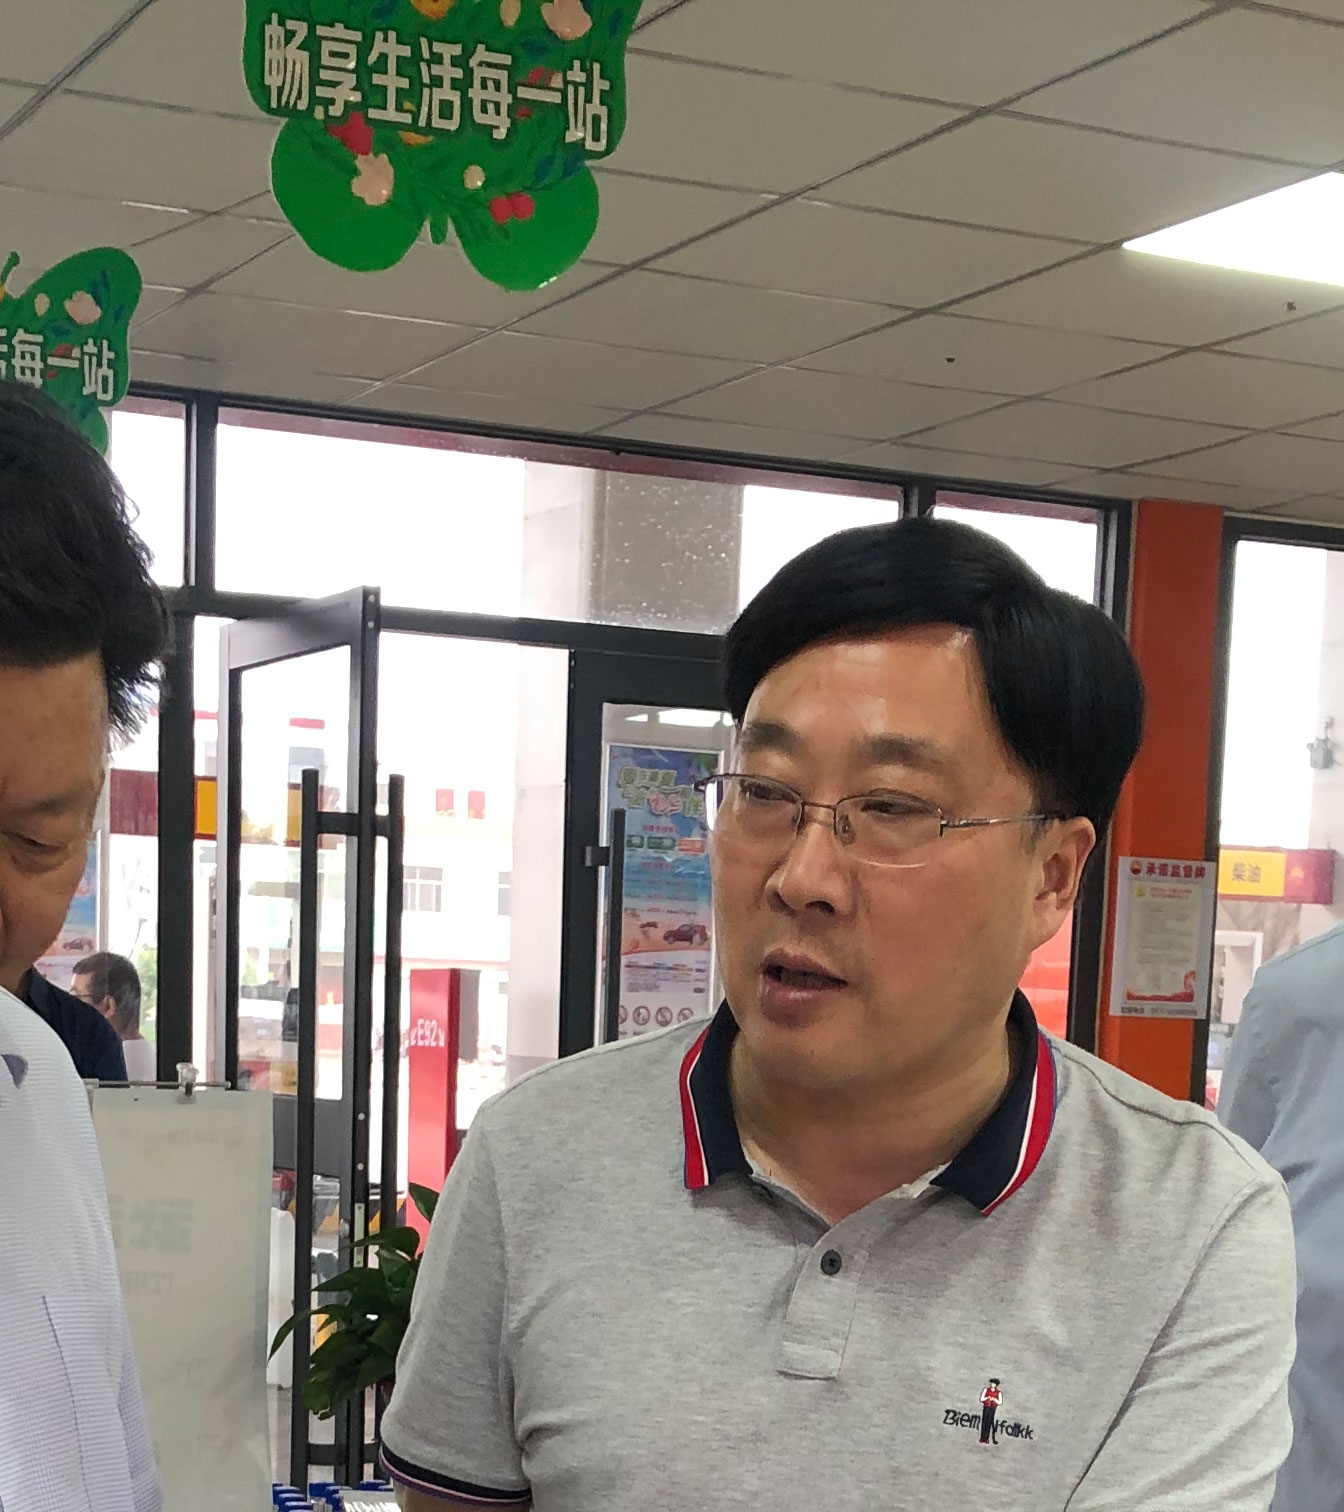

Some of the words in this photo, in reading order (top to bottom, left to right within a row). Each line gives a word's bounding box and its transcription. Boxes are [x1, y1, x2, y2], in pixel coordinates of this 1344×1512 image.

[264, 12, 610, 152] 畅享生活每一站
[1232, 862, 1262, 883] 柴油
